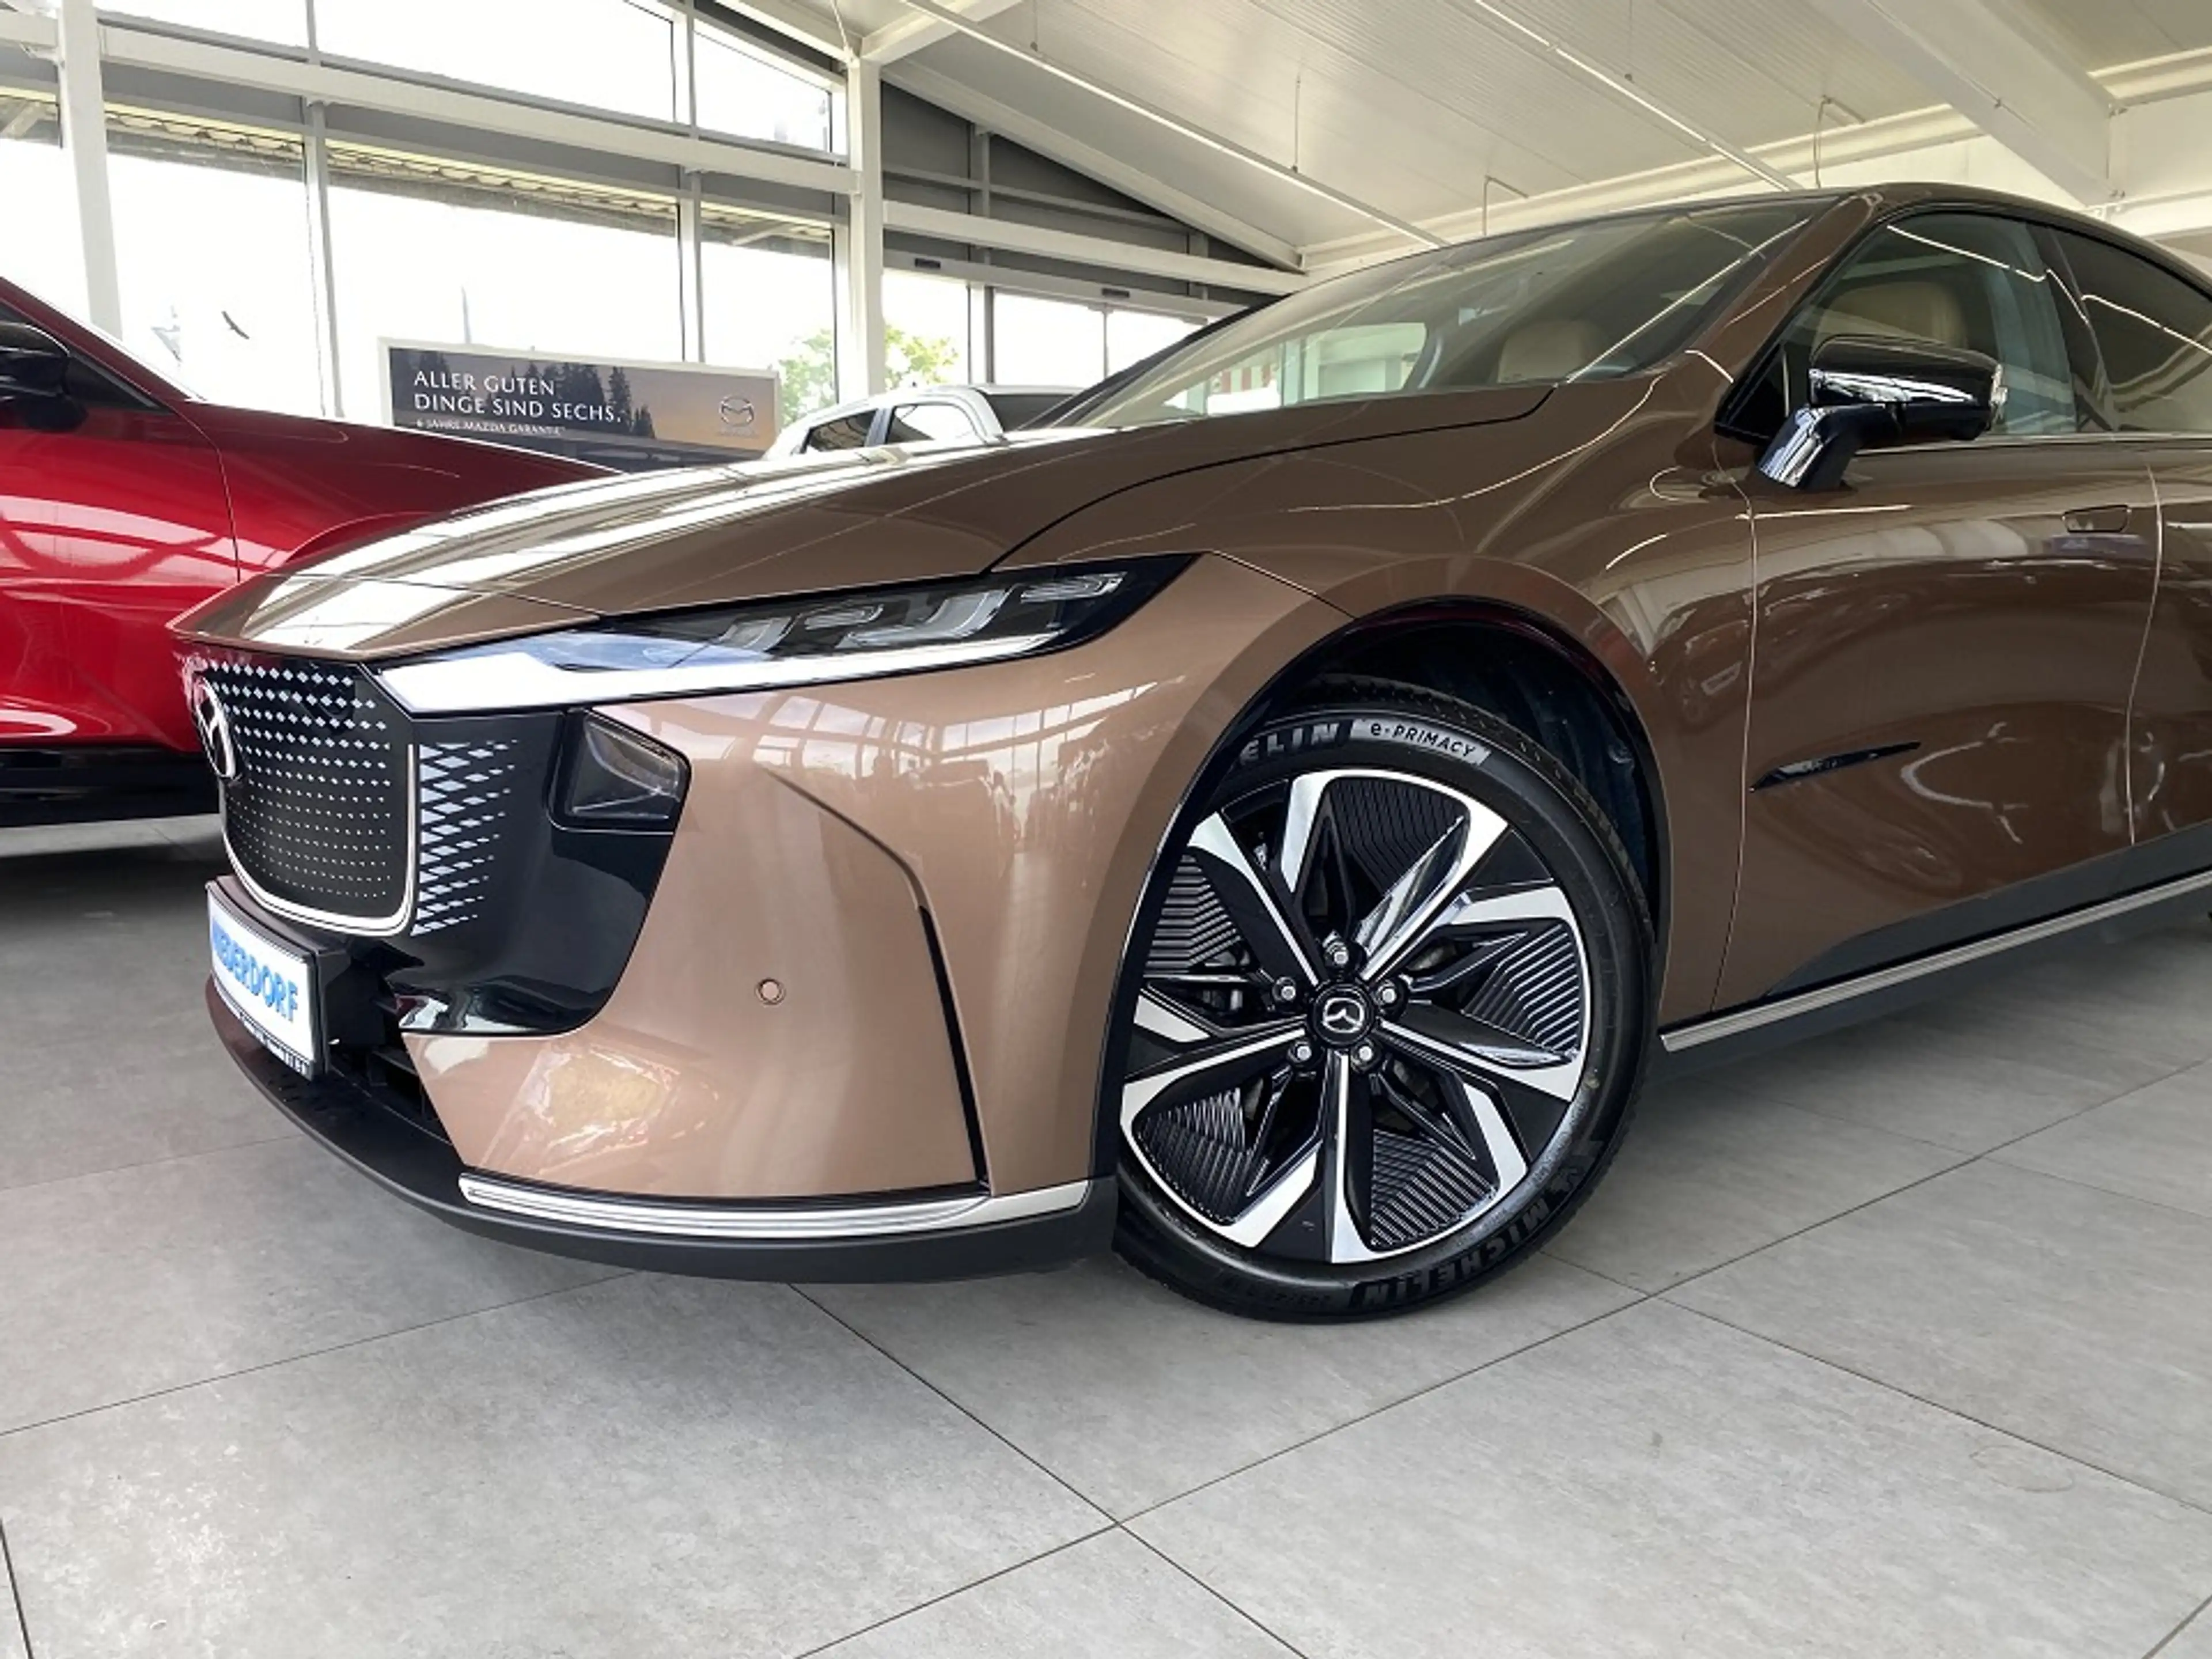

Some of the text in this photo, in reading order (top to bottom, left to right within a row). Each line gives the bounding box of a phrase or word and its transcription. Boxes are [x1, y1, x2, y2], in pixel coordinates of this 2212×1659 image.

[414, 370, 554, 396] ALLER GUTEN
[414, 393, 621, 422] DINGE SIND SECHS.
[1238, 720, 1477, 765] ELIN e-PRIMACY
[1363, 1198, 1550, 1306] MICHELIN
